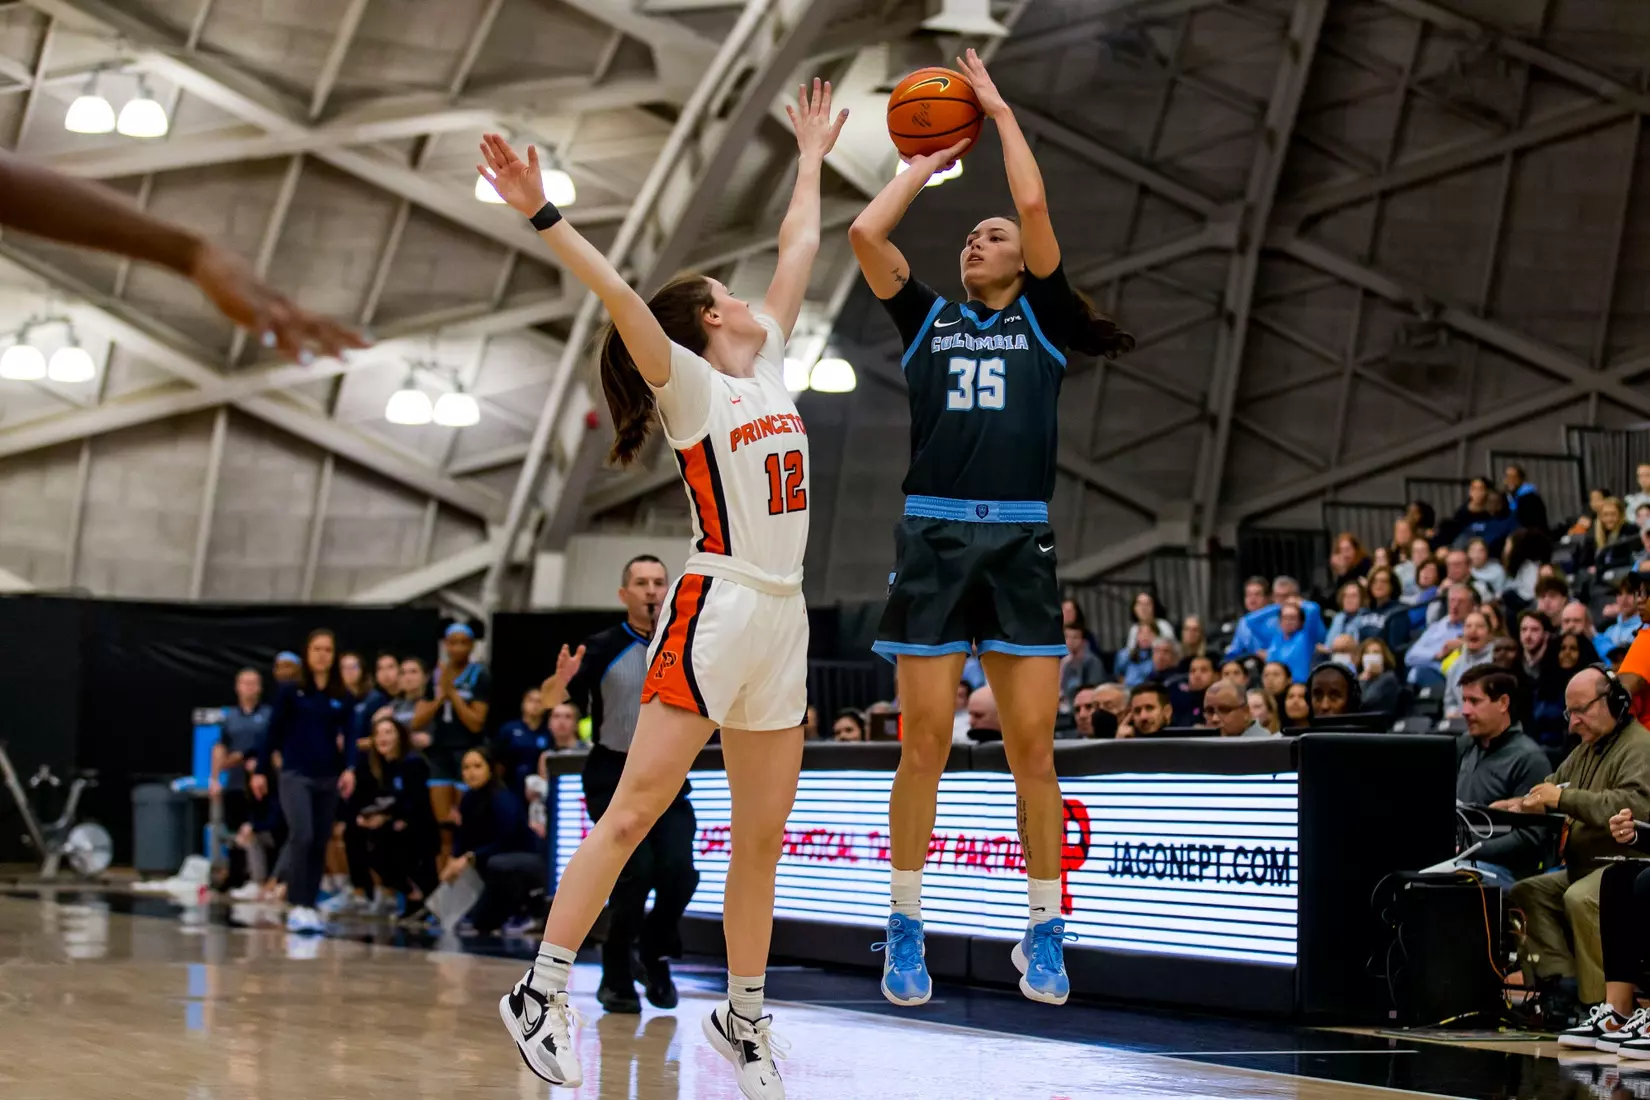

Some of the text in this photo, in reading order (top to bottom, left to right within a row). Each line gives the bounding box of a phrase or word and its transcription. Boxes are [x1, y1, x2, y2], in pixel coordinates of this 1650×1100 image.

[931, 332, 1029, 353] COLUMBIA
[946, 357, 1006, 411] 35
[764, 449, 807, 515] 12
[1108, 841, 1290, 888] JAGONEPT.COM
